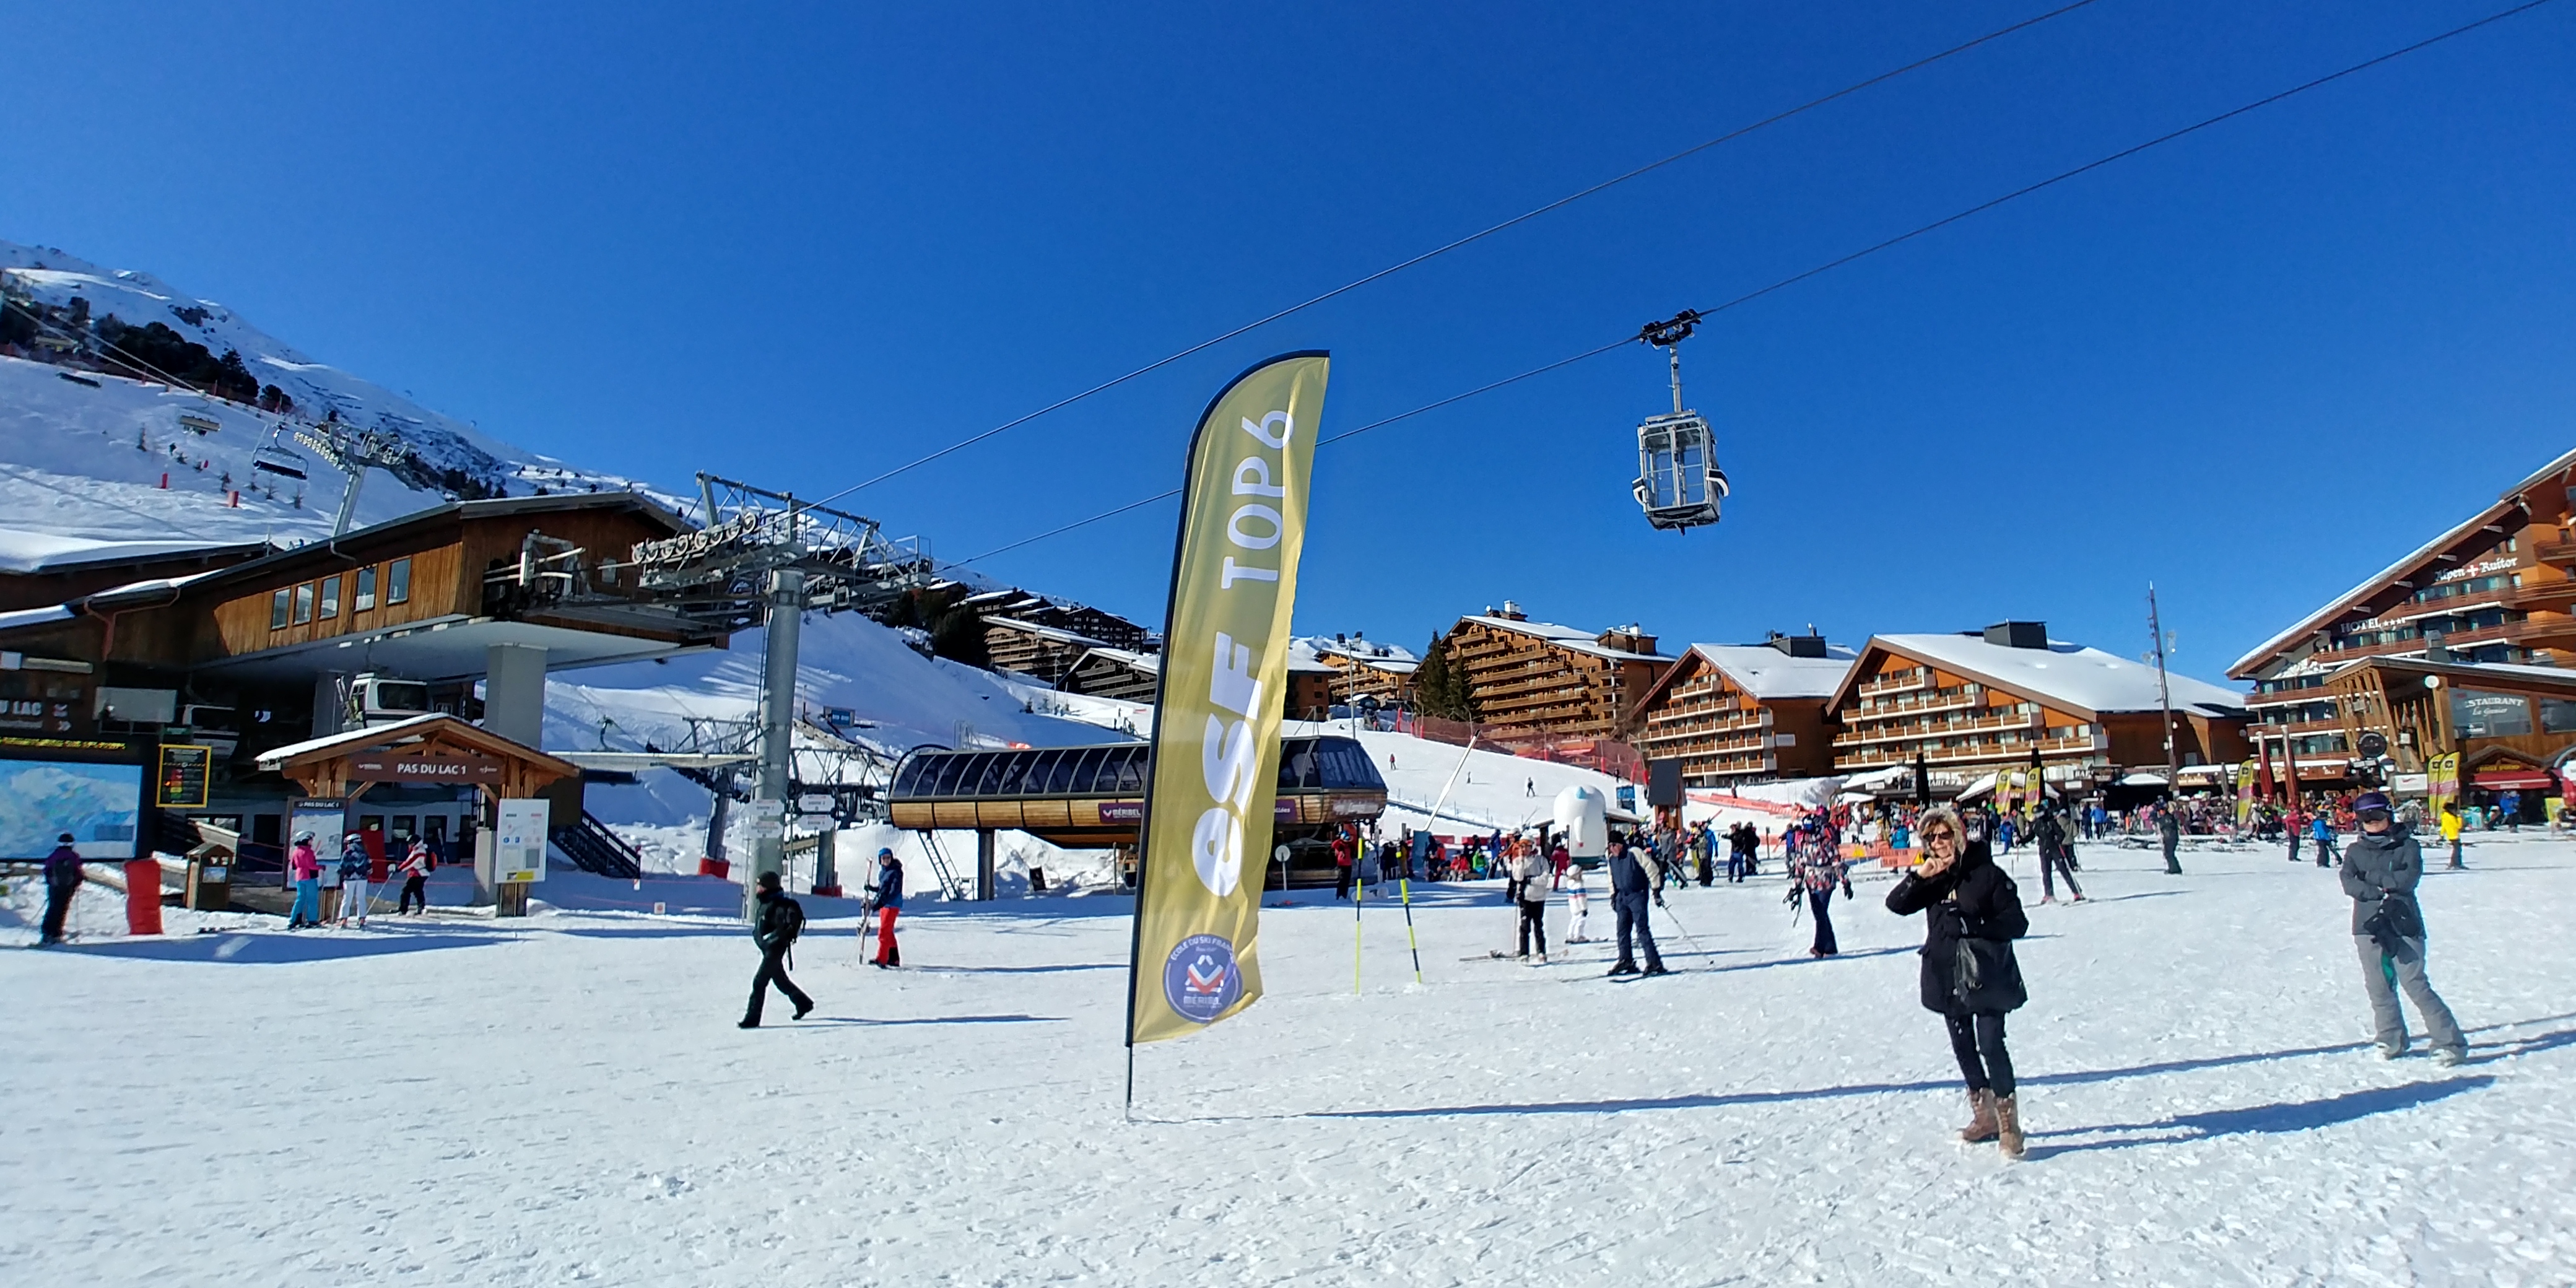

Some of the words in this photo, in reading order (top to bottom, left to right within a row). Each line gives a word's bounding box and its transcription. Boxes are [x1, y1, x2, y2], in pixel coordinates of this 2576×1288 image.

[1241, 410, 1294, 449] 6
[1221, 456, 1286, 589] TOP
[2479, 557, 2517, 573] Ruitor
[2341, 617, 2381, 633] HOTEL
[0, 700, 9, 713] U
[13, 701, 41, 715] LAC
[2465, 697, 2524, 708] STAURANT
[396, 763, 418, 773] PAS
[420, 764, 437, 774] DU
[438, 764, 458, 775] LAC
[461, 765, 466, 775] 1
[1188, 938, 1199, 946] DU
[1199, 936, 1211, 944] SKI
